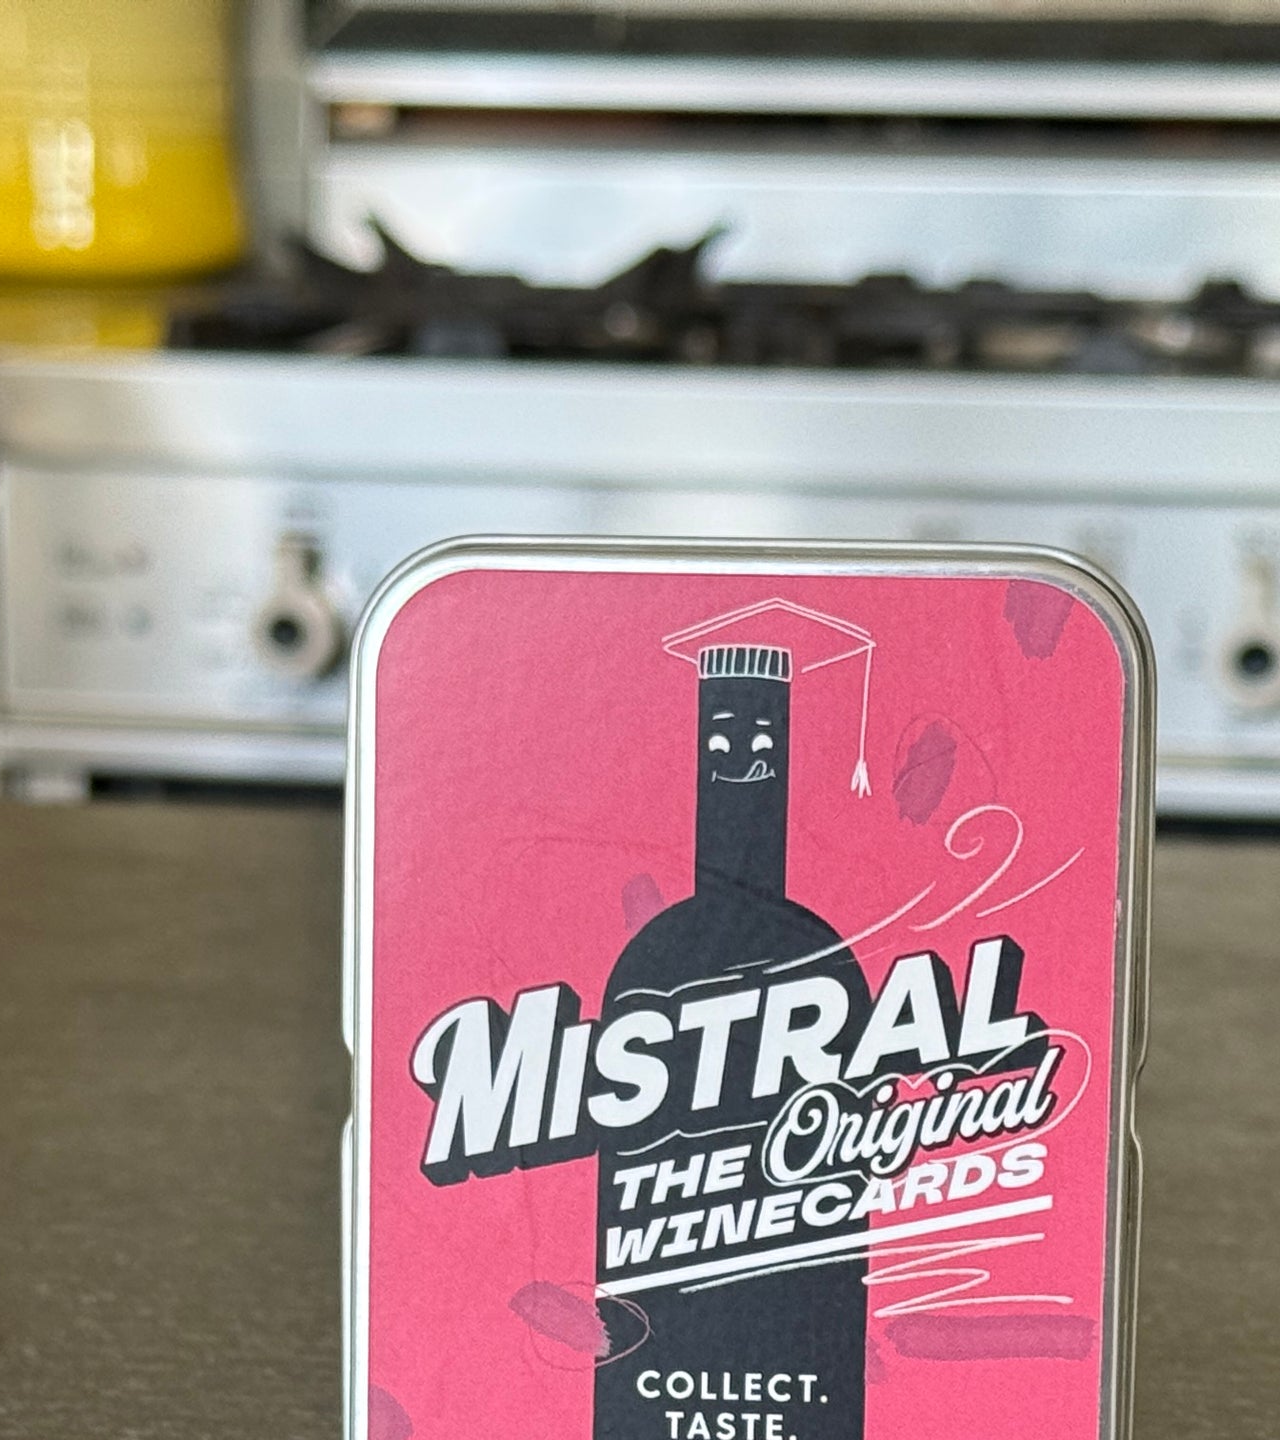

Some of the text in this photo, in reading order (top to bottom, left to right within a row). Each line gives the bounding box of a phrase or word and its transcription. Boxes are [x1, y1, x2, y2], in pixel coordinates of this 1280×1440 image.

[410, 937, 1034, 1166] MISTRAL
[613, 1048, 1059, 1211] THE Original
[604, 1142, 1047, 1270] WINECARDS
[637, 1370, 828, 1403] COLLECT.
